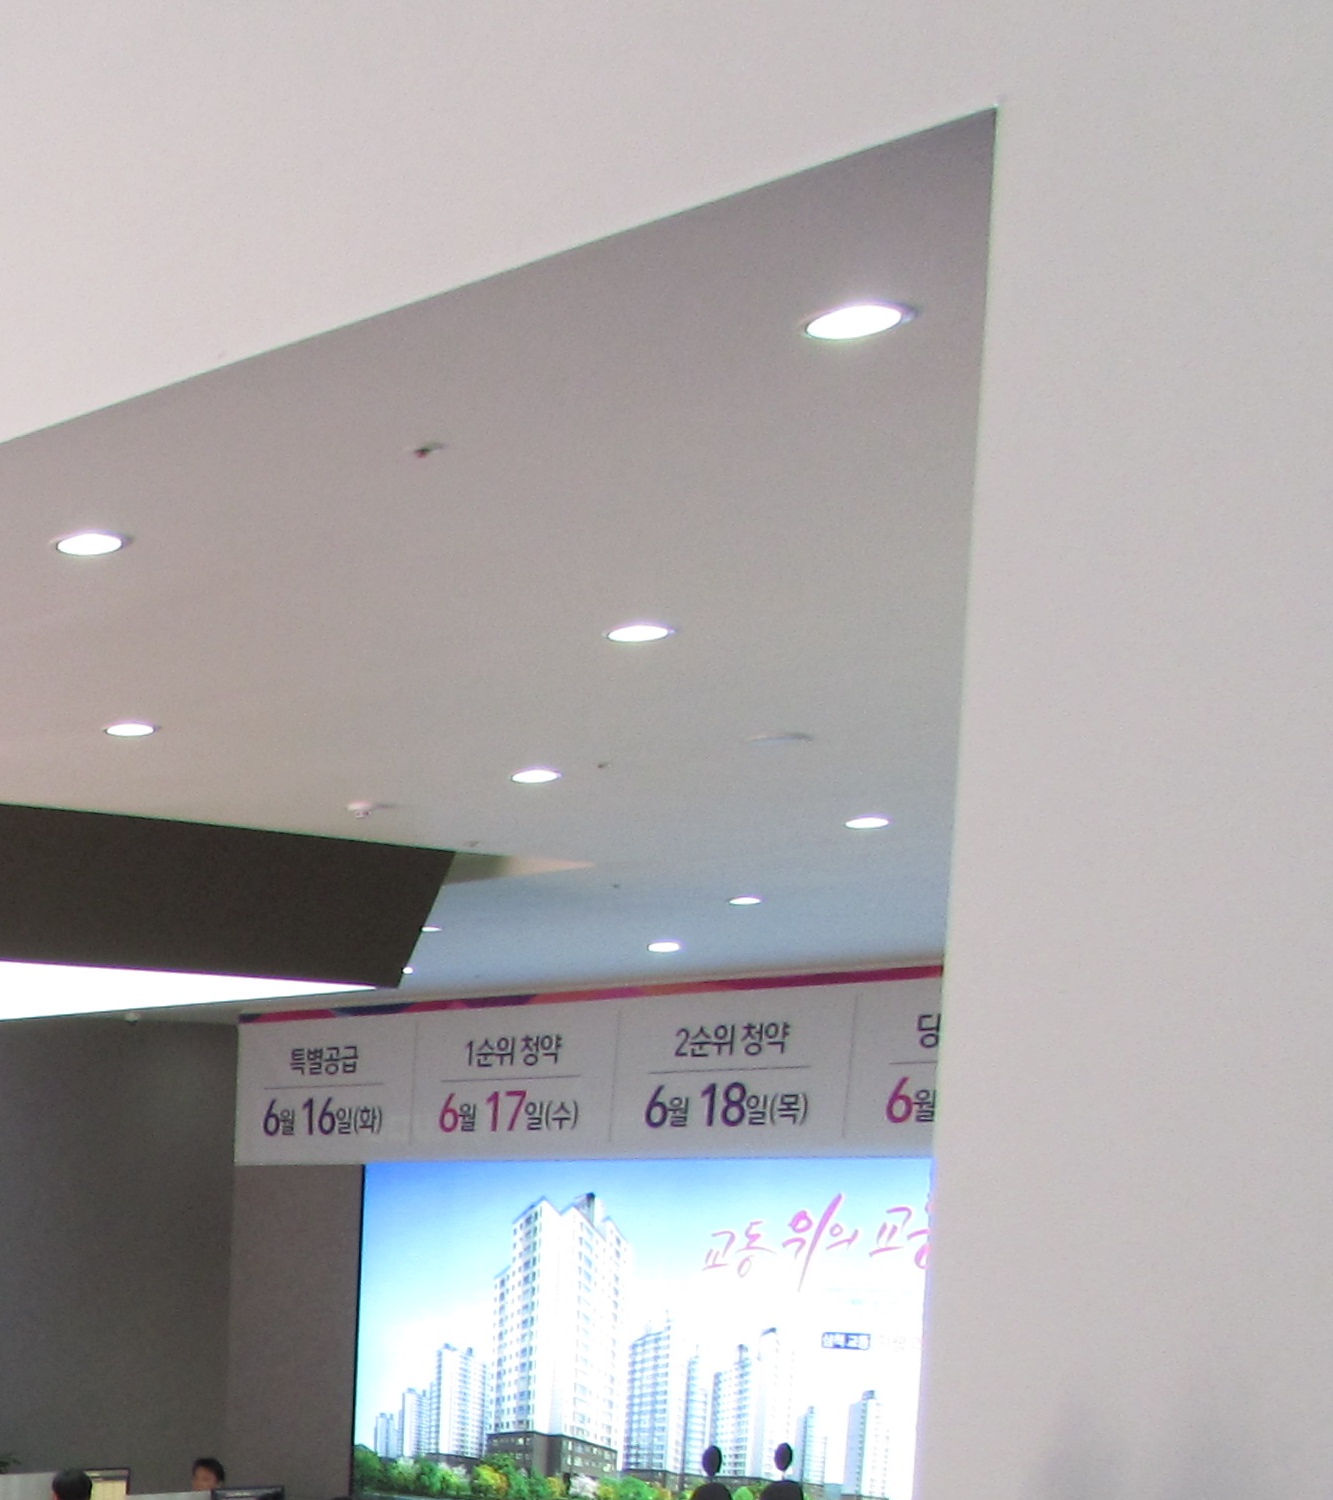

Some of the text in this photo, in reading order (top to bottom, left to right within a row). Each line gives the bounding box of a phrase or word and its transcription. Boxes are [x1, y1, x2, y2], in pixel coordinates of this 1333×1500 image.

[467, 1034, 563, 1067] 1순위 청약
[674, 1021, 790, 1057] 2순위 청약
[290, 1045, 358, 1076] 특별공급
[263, 1097, 382, 1137] 6월 16일(화)
[439, 1090, 579, 1133] 6월 17일(수)
[645, 1081, 808, 1128] 6월 18일(목)
[886, 1076, 937, 1123] 6월
[701, 1221, 777, 1278] 교동
